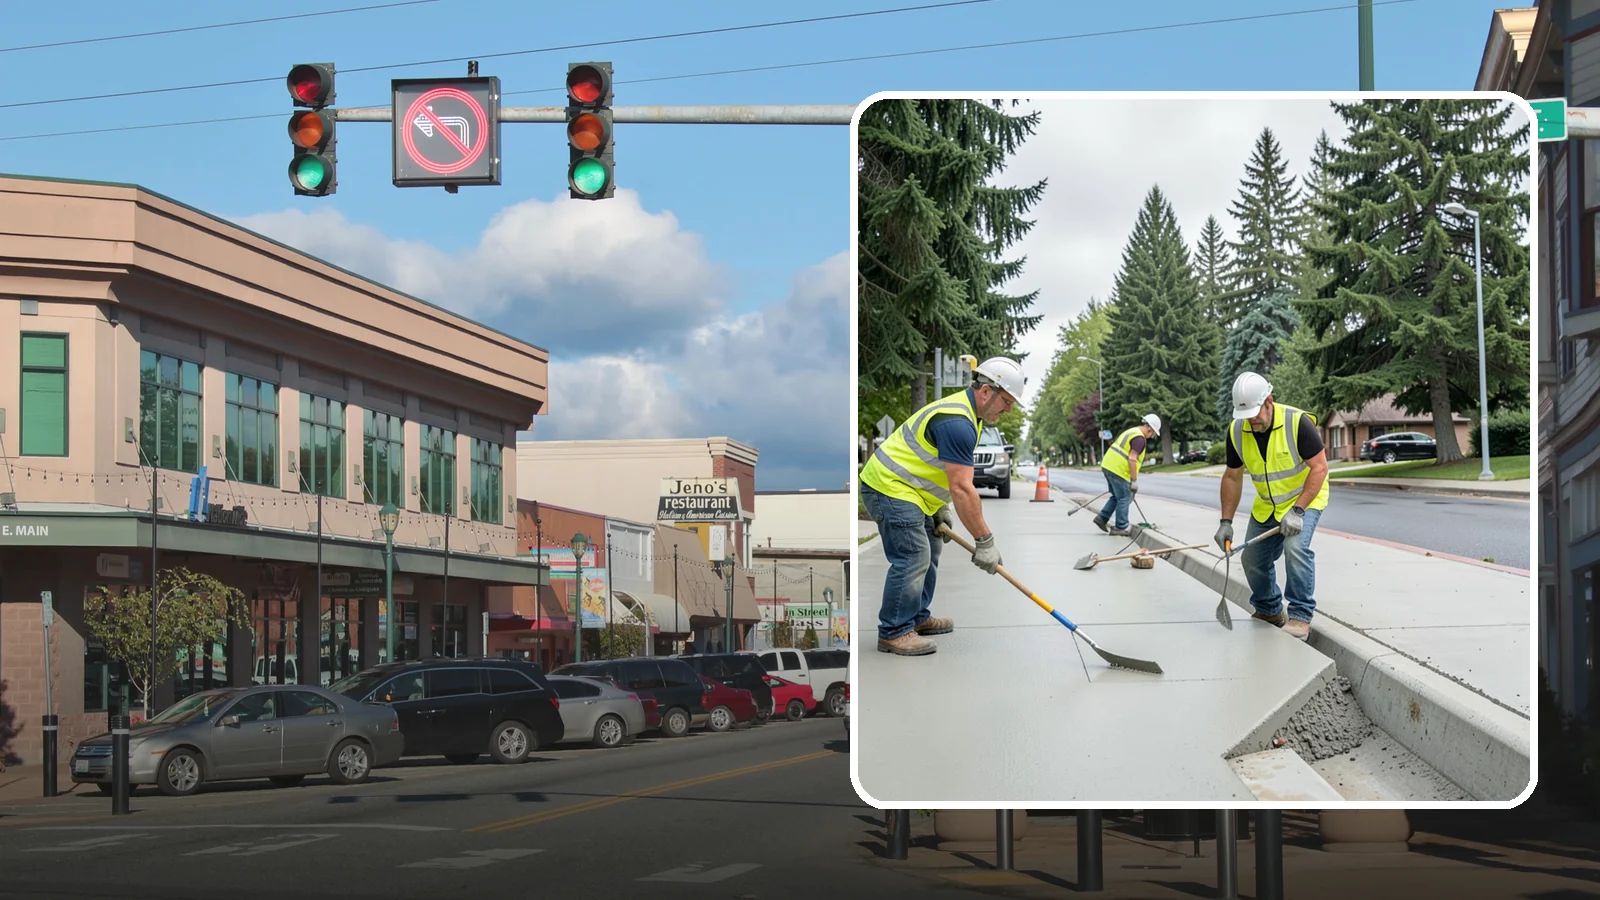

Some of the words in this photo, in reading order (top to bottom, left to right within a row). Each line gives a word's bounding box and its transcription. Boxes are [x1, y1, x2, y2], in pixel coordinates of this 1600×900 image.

[670, 480, 727, 494] Jeno's
[665, 497, 731, 509] restaurant
[658, 510, 681, 519] Italian
[686, 510, 714, 519] American
[715, 510, 738, 519] Cuisine
[2, 525, 13, 536] E.
[15, 525, 49, 536] MAIN
[785, 607, 795, 617] in
[797, 607, 828, 617] Street
[791, 619, 823, 627] lass
